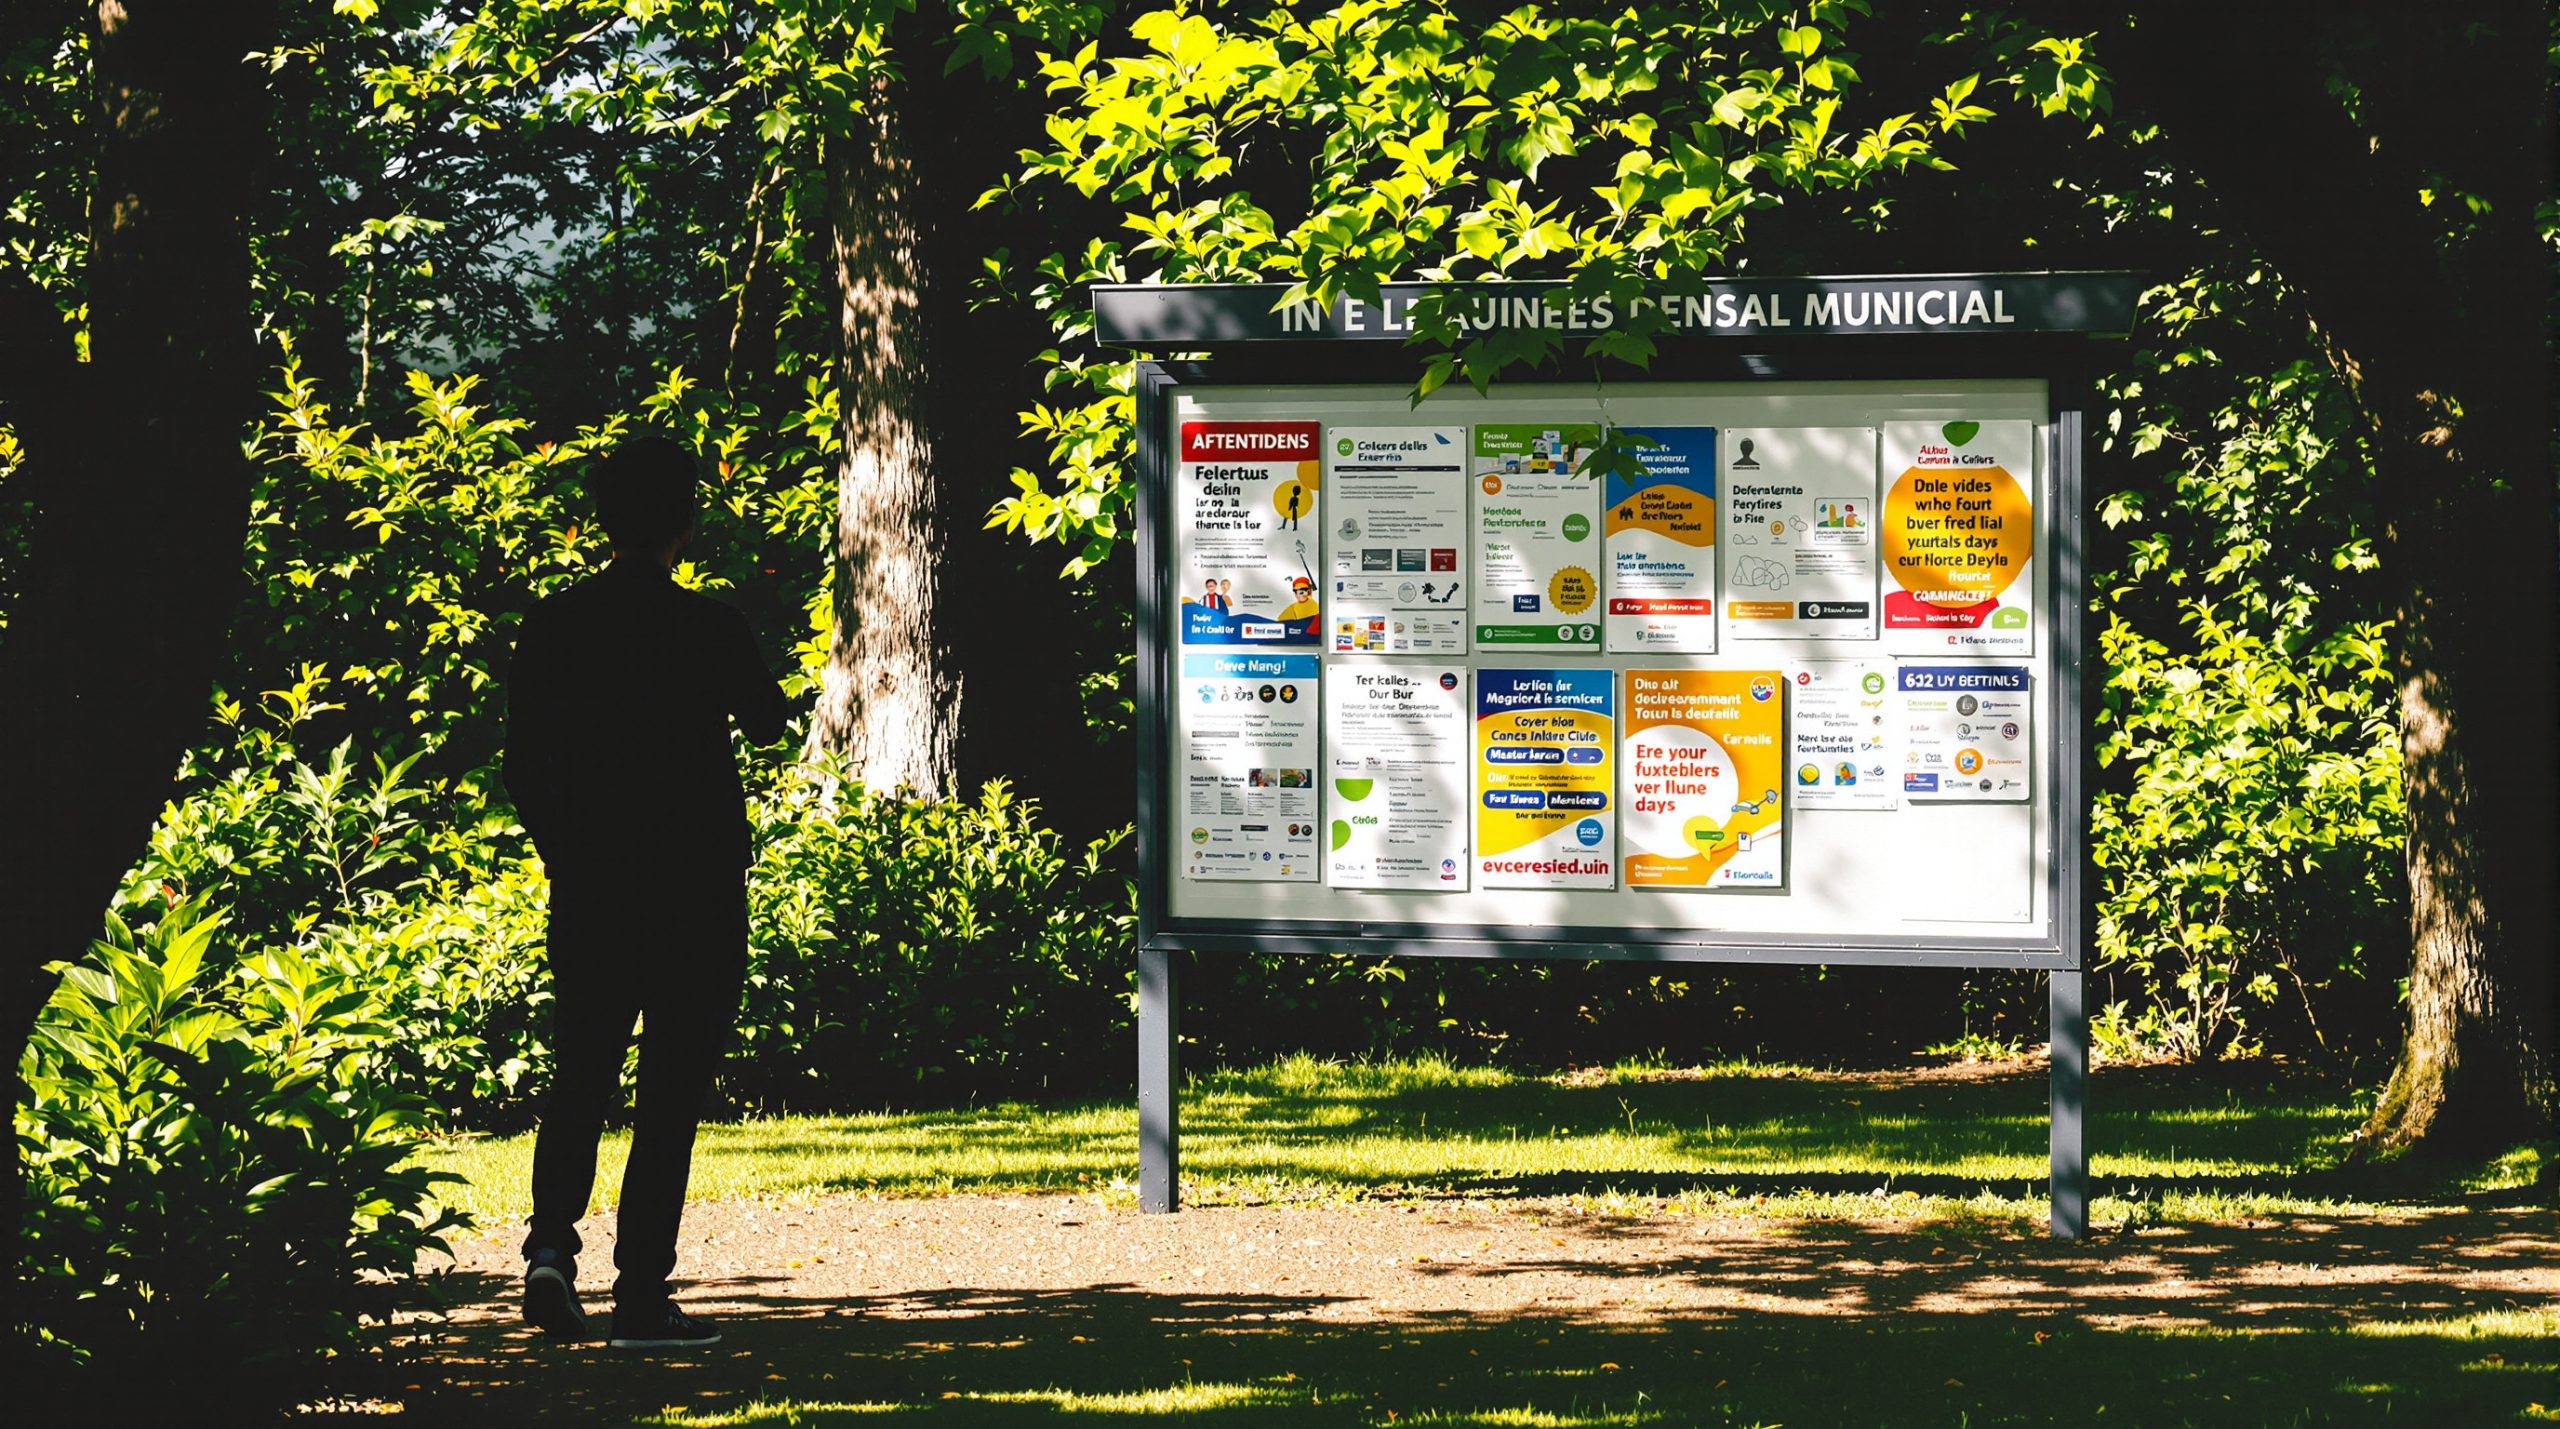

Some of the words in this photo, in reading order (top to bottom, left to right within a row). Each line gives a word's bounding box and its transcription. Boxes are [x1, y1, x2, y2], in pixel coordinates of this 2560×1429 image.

[1282, 298, 1320, 332] IN
[1803, 289, 2015, 326] MUNICIAL
[1192, 433, 1309, 449] AFTENTIDENS
[1953, 478, 1992, 493] vides
[1944, 515, 1976, 530] fred
[1965, 535, 1999, 550] days
[1369, 689, 1390, 699] Our
[1392, 688, 1414, 700] Bur
[1636, 744, 1664, 759] Ere
[1669, 747, 1707, 761] your
[1635, 761, 1720, 777] fuxteblers
[1634, 783, 1661, 794] ver
[1635, 797, 1676, 814] days
